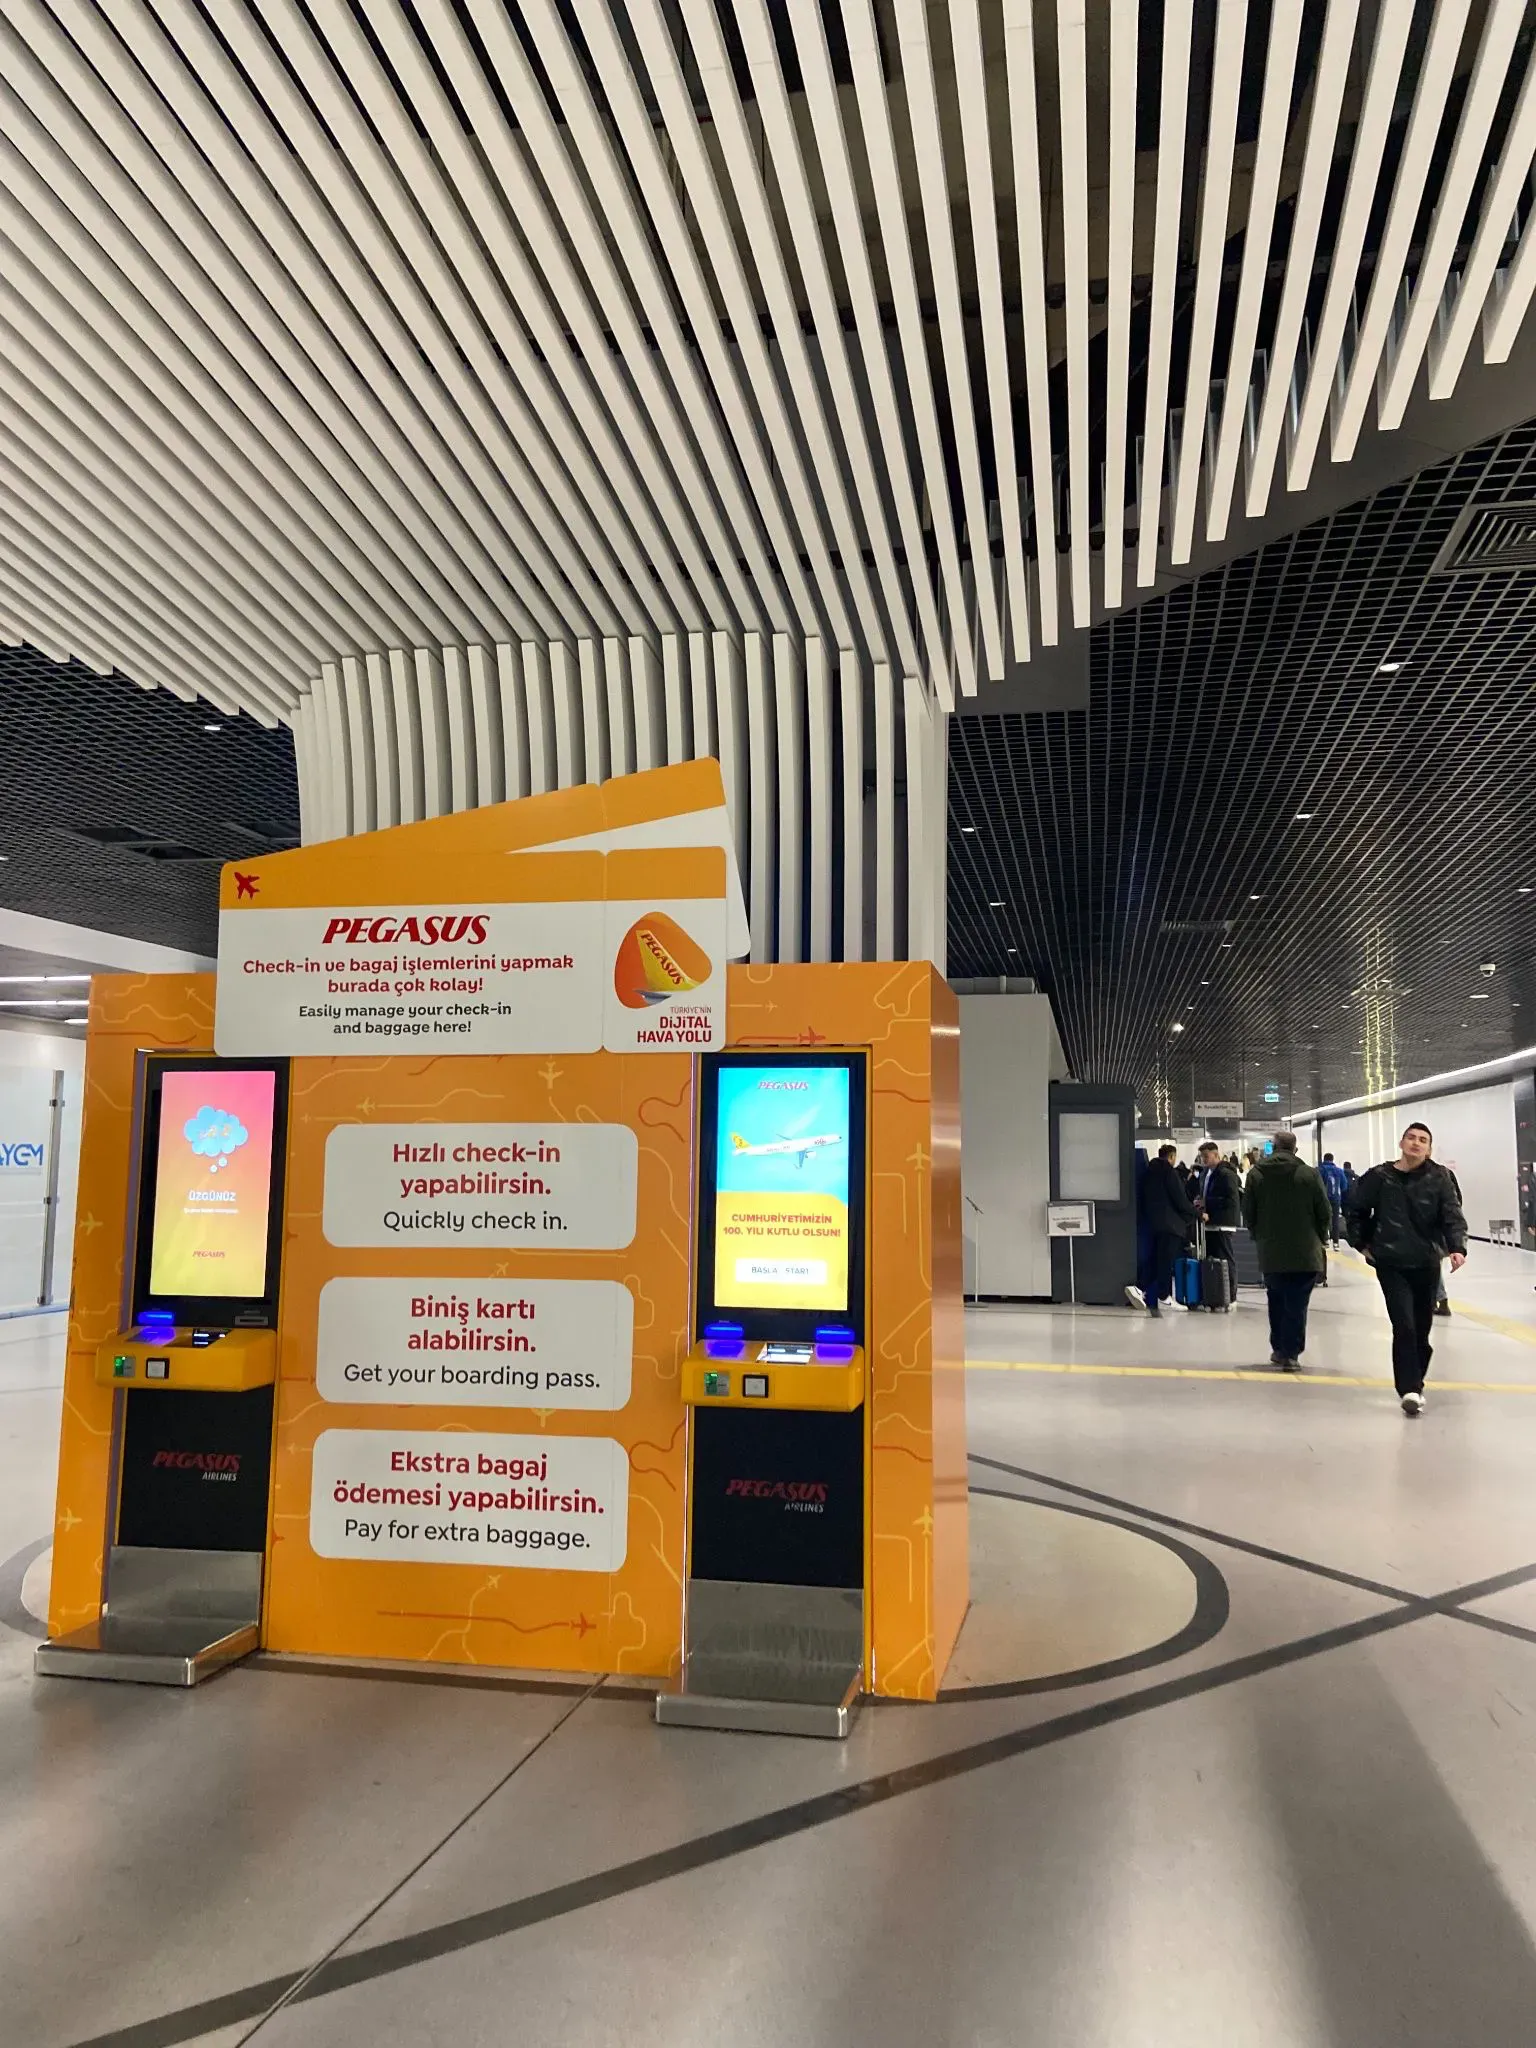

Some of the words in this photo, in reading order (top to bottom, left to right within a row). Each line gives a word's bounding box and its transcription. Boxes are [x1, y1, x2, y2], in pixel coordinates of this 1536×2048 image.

[322, 914, 491, 946] PEGASUS
[243, 957, 321, 974] Check-in
[325, 960, 346, 972] ve
[350, 955, 398, 974] bagaj
[402, 954, 496, 976] işlemlerini
[500, 955, 574, 972] yapmak
[640, 933, 685, 985] PEGASUS
[328, 979, 390, 993] burada
[394, 978, 426, 996] çok
[429, 977, 483, 994] kolay!
[299, 1004, 342, 1019] Easily
[345, 1006, 405, 1019] manage
[408, 1005, 443, 1018] your
[446, 1002, 512, 1016] check-in
[333, 1022, 361, 1034] and
[365, 1021, 430, 1036] baggage
[433, 1020, 472, 1033] here!
[637, 1030, 674, 1043] HAVA
[676, 1030, 712, 1043] YOLU
[757, 1081, 809, 1091] PEGASUS
[393, 1142, 446, 1163] Hızlı
[452, 1140, 561, 1163] check-in
[399, 1171, 552, 1198] yapabilirsin.
[383, 1210, 465, 1232] Quickly
[471, 1211, 537, 1230] check
[542, 1210, 568, 1231] in.
[767, 1227, 800, 1237] KUTLU
[410, 1295, 469, 1326] Biniş
[476, 1298, 536, 1319] kartı
[407, 1327, 537, 1353] alabilirsin.
[344, 1363, 383, 1383] Get
[387, 1368, 436, 1386] your
[441, 1365, 540, 1390] boarding
[546, 1371, 601, 1391] pass.
[153, 1450, 242, 1471] PEGASUS
[390, 1451, 470, 1474] Ekstra
[477, 1453, 548, 1482] bagaj
[202, 1471, 237, 1481] AIRLINES
[333, 1480, 441, 1506] ödemesi
[448, 1486, 605, 1514] yapabilirsin.
[726, 1479, 829, 1502] PEGASUS
[784, 1502, 824, 1513] AIRLINES
[344, 1518, 383, 1542] Pay
[388, 1519, 420, 1540] for
[424, 1523, 480, 1543] extra
[486, 1524, 591, 1551] baggage.
